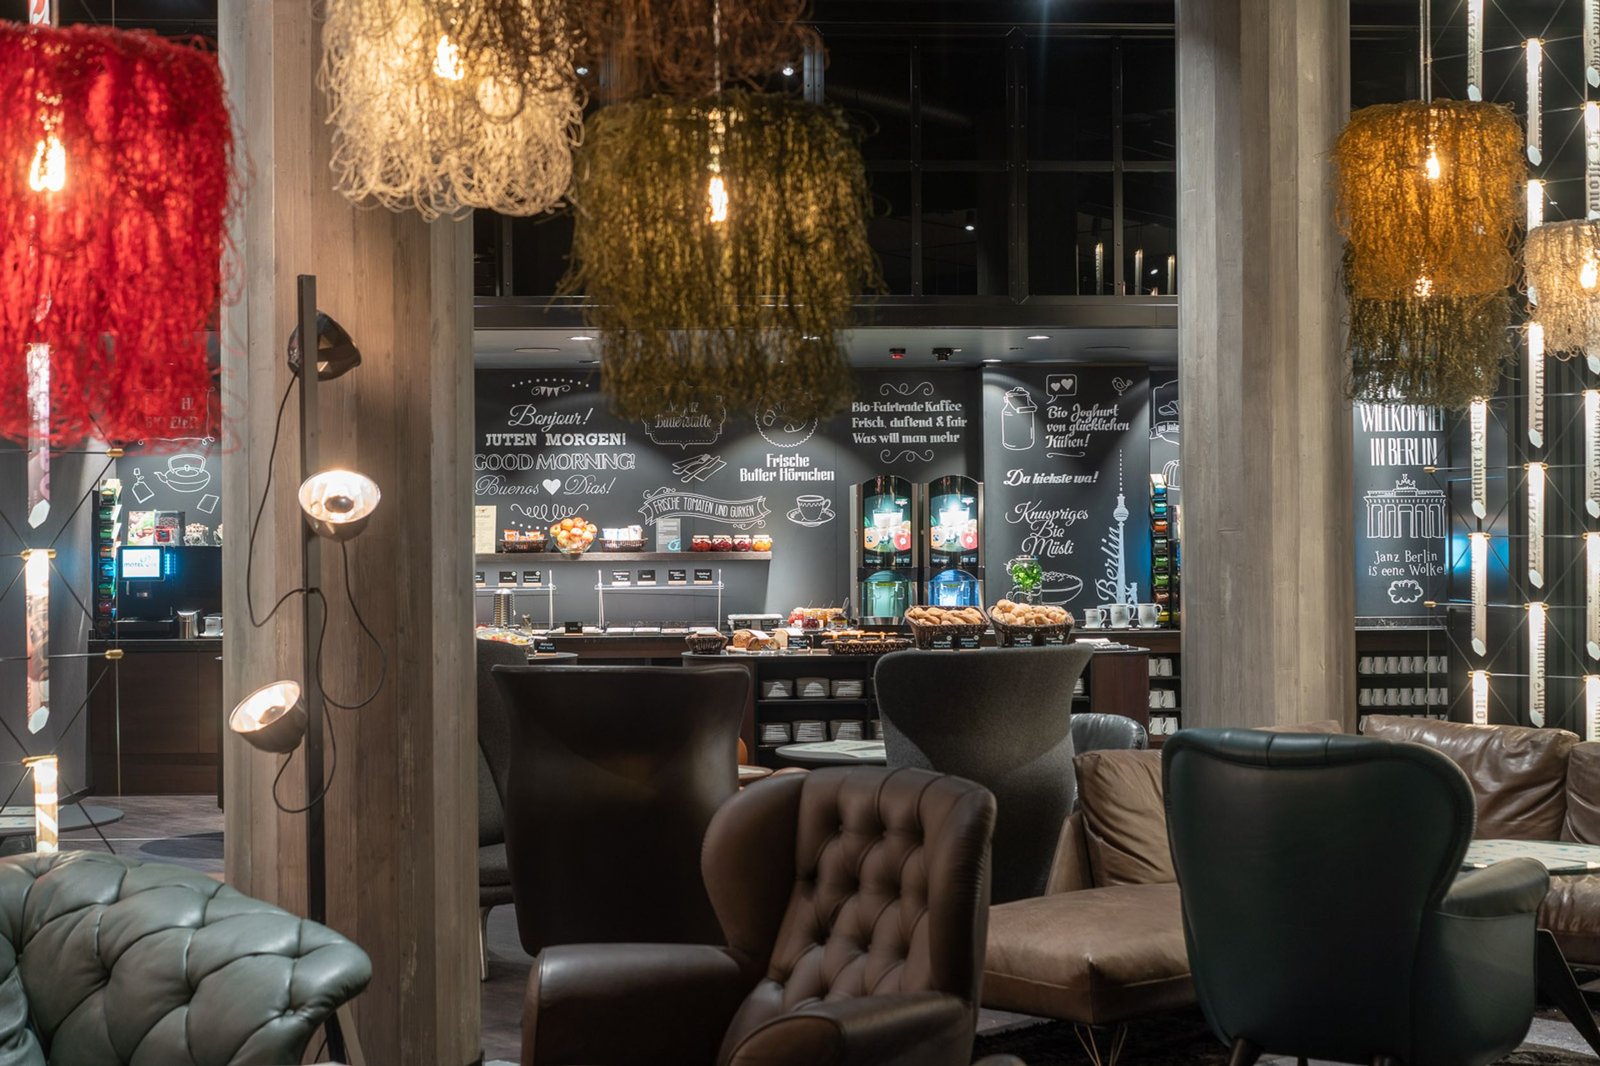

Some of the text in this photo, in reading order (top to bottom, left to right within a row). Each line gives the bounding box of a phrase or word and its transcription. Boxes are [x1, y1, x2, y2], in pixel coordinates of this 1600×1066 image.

[851, 399, 963, 413] Bio-Fairtrade Kaffee
[1046, 403, 1120, 424] Bio Joghurt
[507, 403, 594, 433] Bonjour!
[851, 415, 968, 429] Frisch, duftend & fair
[1046, 417, 1131, 437] von glücklichen
[485, 432, 627, 446] JUTEN MORGEN!
[852, 431, 960, 444] Was will man mehr
[1045, 433, 1091, 448] Kühen!
[766, 453, 810, 468] Frische
[1370, 437, 1385, 466] IN
[474, 453, 636, 471] GOOD MORNING!
[739, 467, 835, 482] Butter Hörnchen
[1003, 468, 1099, 486] Da kiekste wa!
[475, 474, 617, 496] Buenos Dias!
[652, 496, 755, 518] FRISCHE TOMATEN UND GURKEN
[1005, 500, 1089, 527] Knuspriges
[1030, 519, 1065, 539] Bio
[1021, 536, 1075, 558] Müsli
[1094, 526, 1119, 604] Berlin
[1373, 549, 1438, 565] Janz Berlin
[1368, 563, 1447, 577] is eene Wolke!
